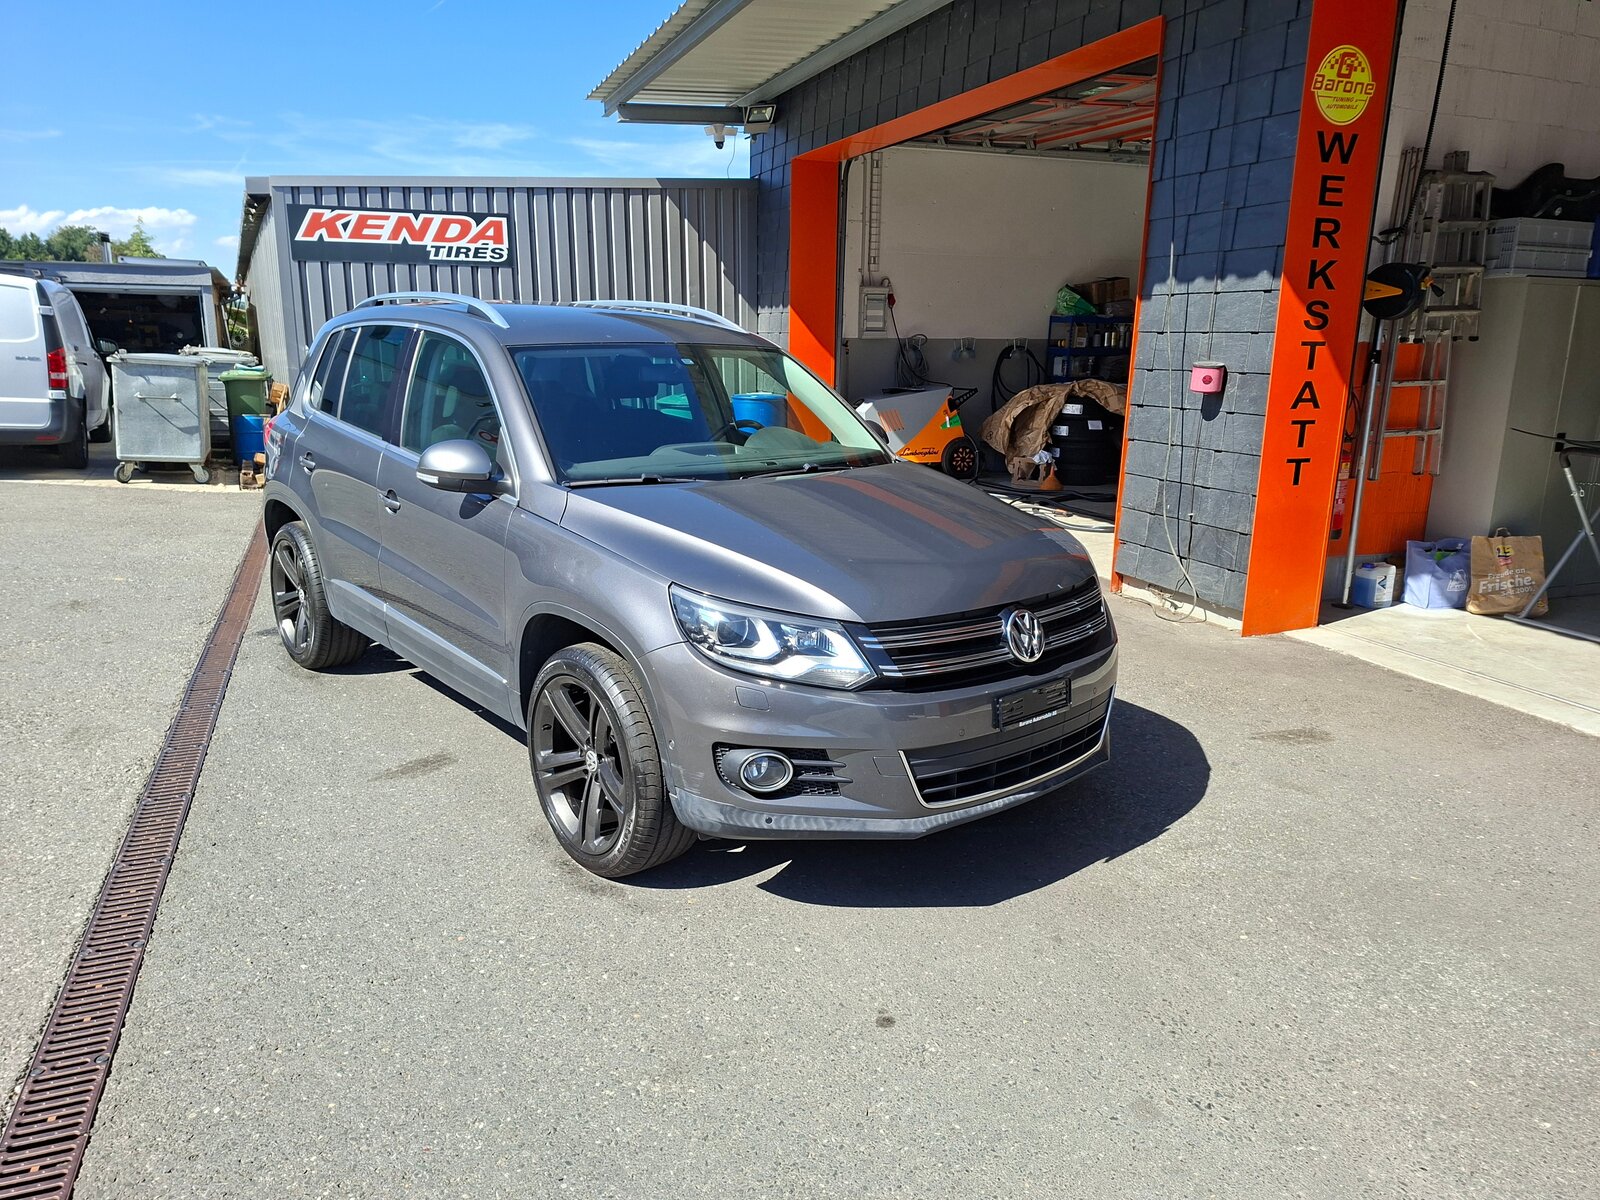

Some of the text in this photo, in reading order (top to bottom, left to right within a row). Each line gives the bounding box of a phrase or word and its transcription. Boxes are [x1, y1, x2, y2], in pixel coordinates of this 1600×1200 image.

[1312, 73, 1375, 96] Barone
[298, 210, 507, 245] KENDA
[428, 245, 507, 260] TIRES
[1286, 130, 1359, 486] WERKSTATT
[1478, 575, 1536, 594] Frische.
